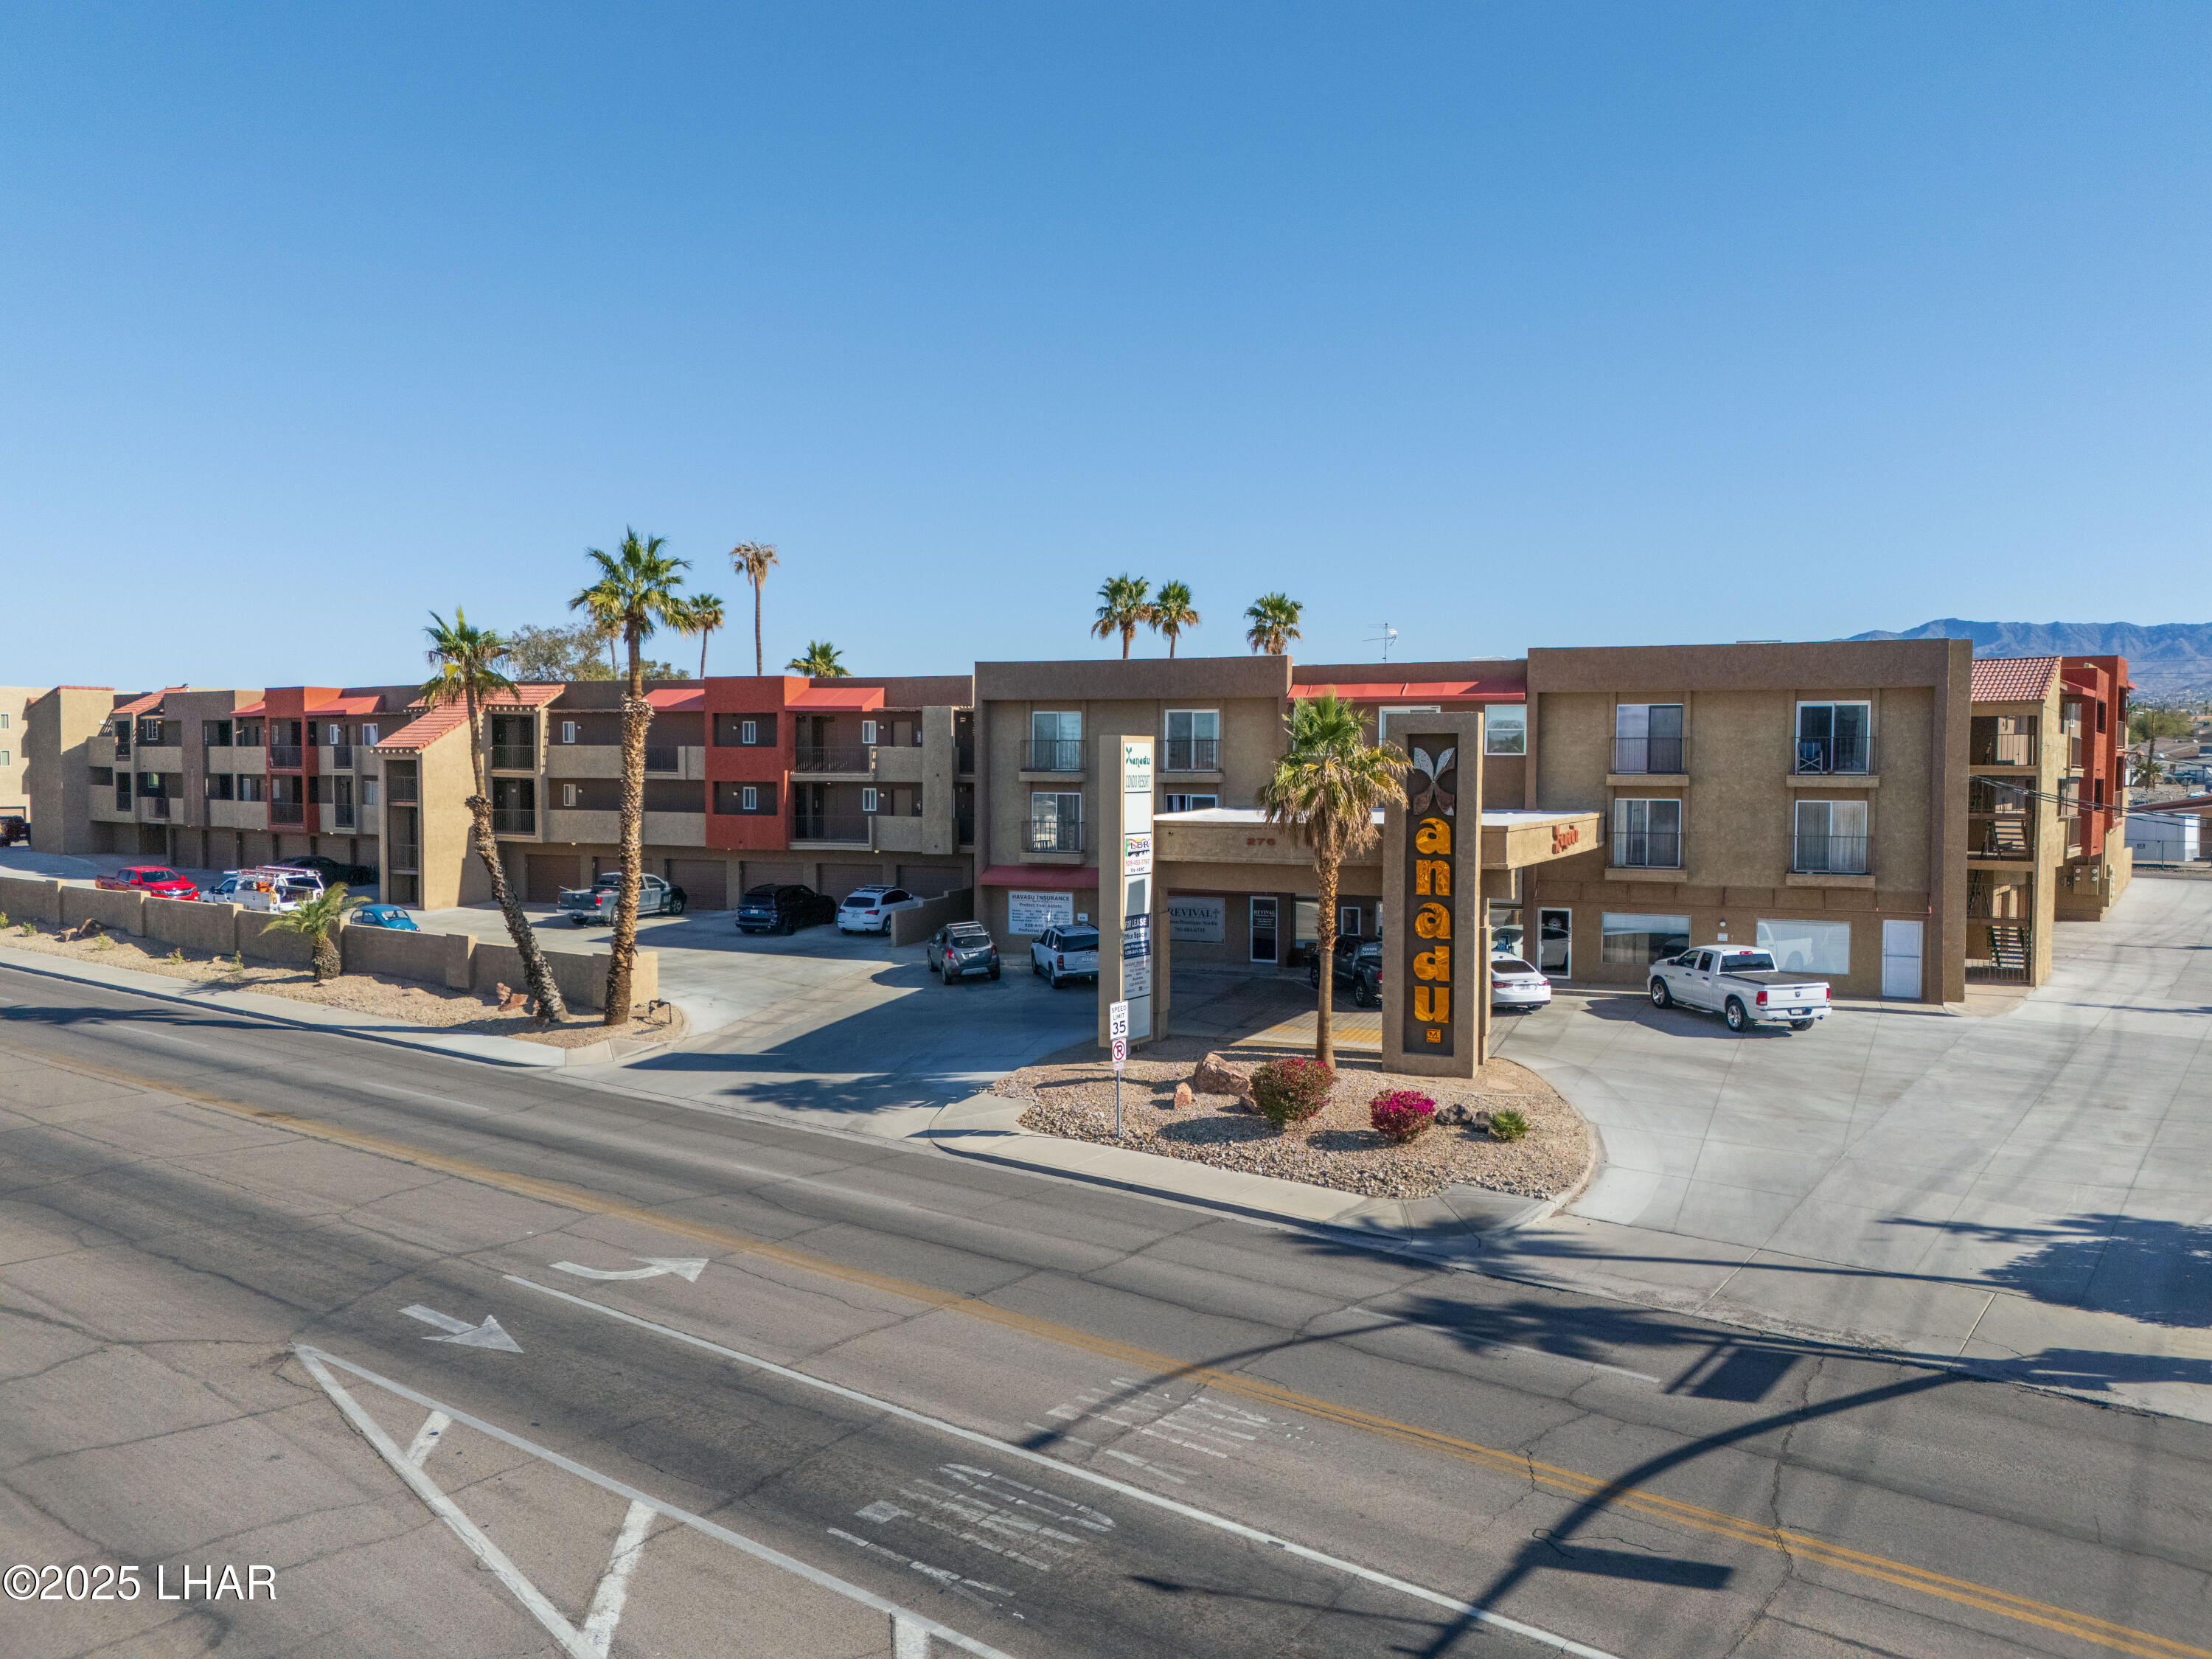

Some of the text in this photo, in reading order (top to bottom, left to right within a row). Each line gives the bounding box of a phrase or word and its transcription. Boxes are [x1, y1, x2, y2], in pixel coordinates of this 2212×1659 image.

[1125, 746, 1150, 768] Xanadu
[1126, 774, 1150, 788] CONDO RESORT
[1168, 908, 1212, 917] REVIVAL
[1132, 917, 1147, 927] LEASE
[1111, 1005, 1127, 1013] SPEED
[1113, 1012, 1124, 1020] LIMIT
[1113, 1020, 1126, 1035] 35
[827, 1463, 1117, 1600] ONLY
